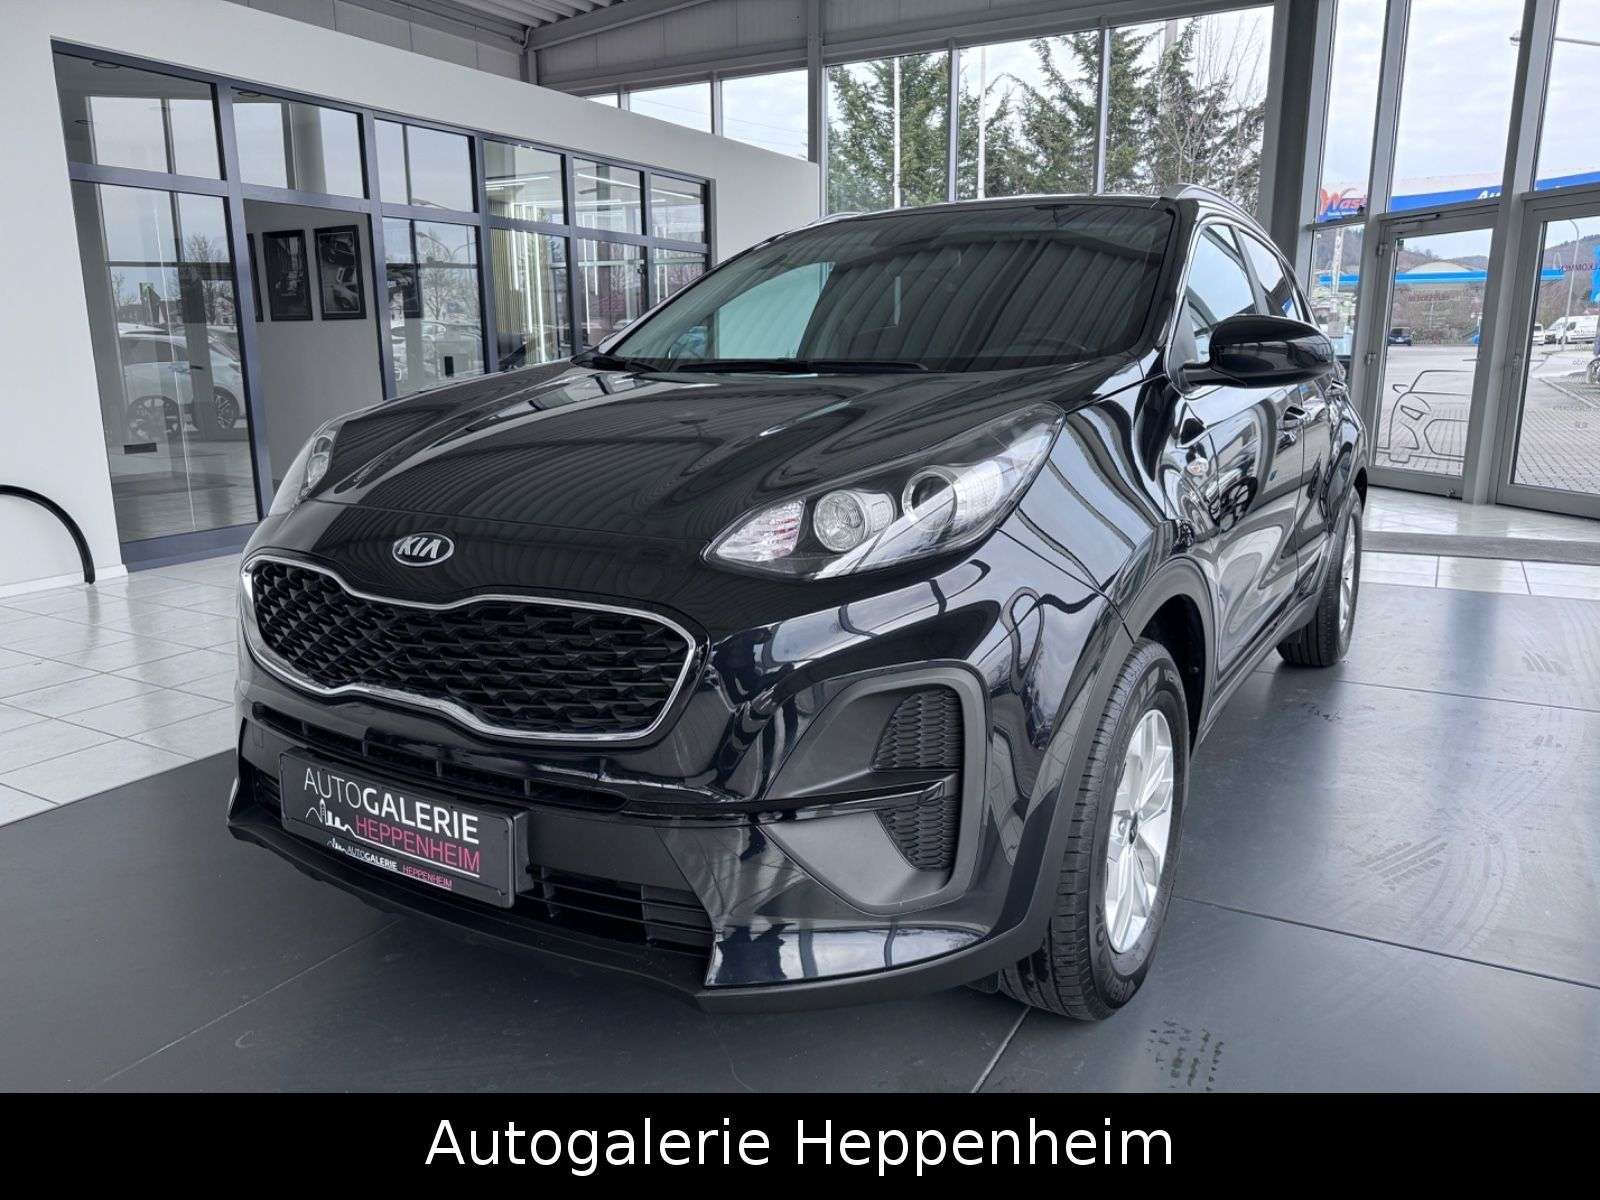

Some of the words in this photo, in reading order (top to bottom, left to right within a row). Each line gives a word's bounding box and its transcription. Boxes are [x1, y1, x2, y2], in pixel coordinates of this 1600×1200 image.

[397, 536, 442, 559] KIA
[304, 767, 480, 844] AUTOGALERIE
[347, 846, 398, 871] AUTOGALERIE
[402, 865, 453, 890] HEPPENHEIM
[355, 815, 481, 873] HEPPENHEIM
